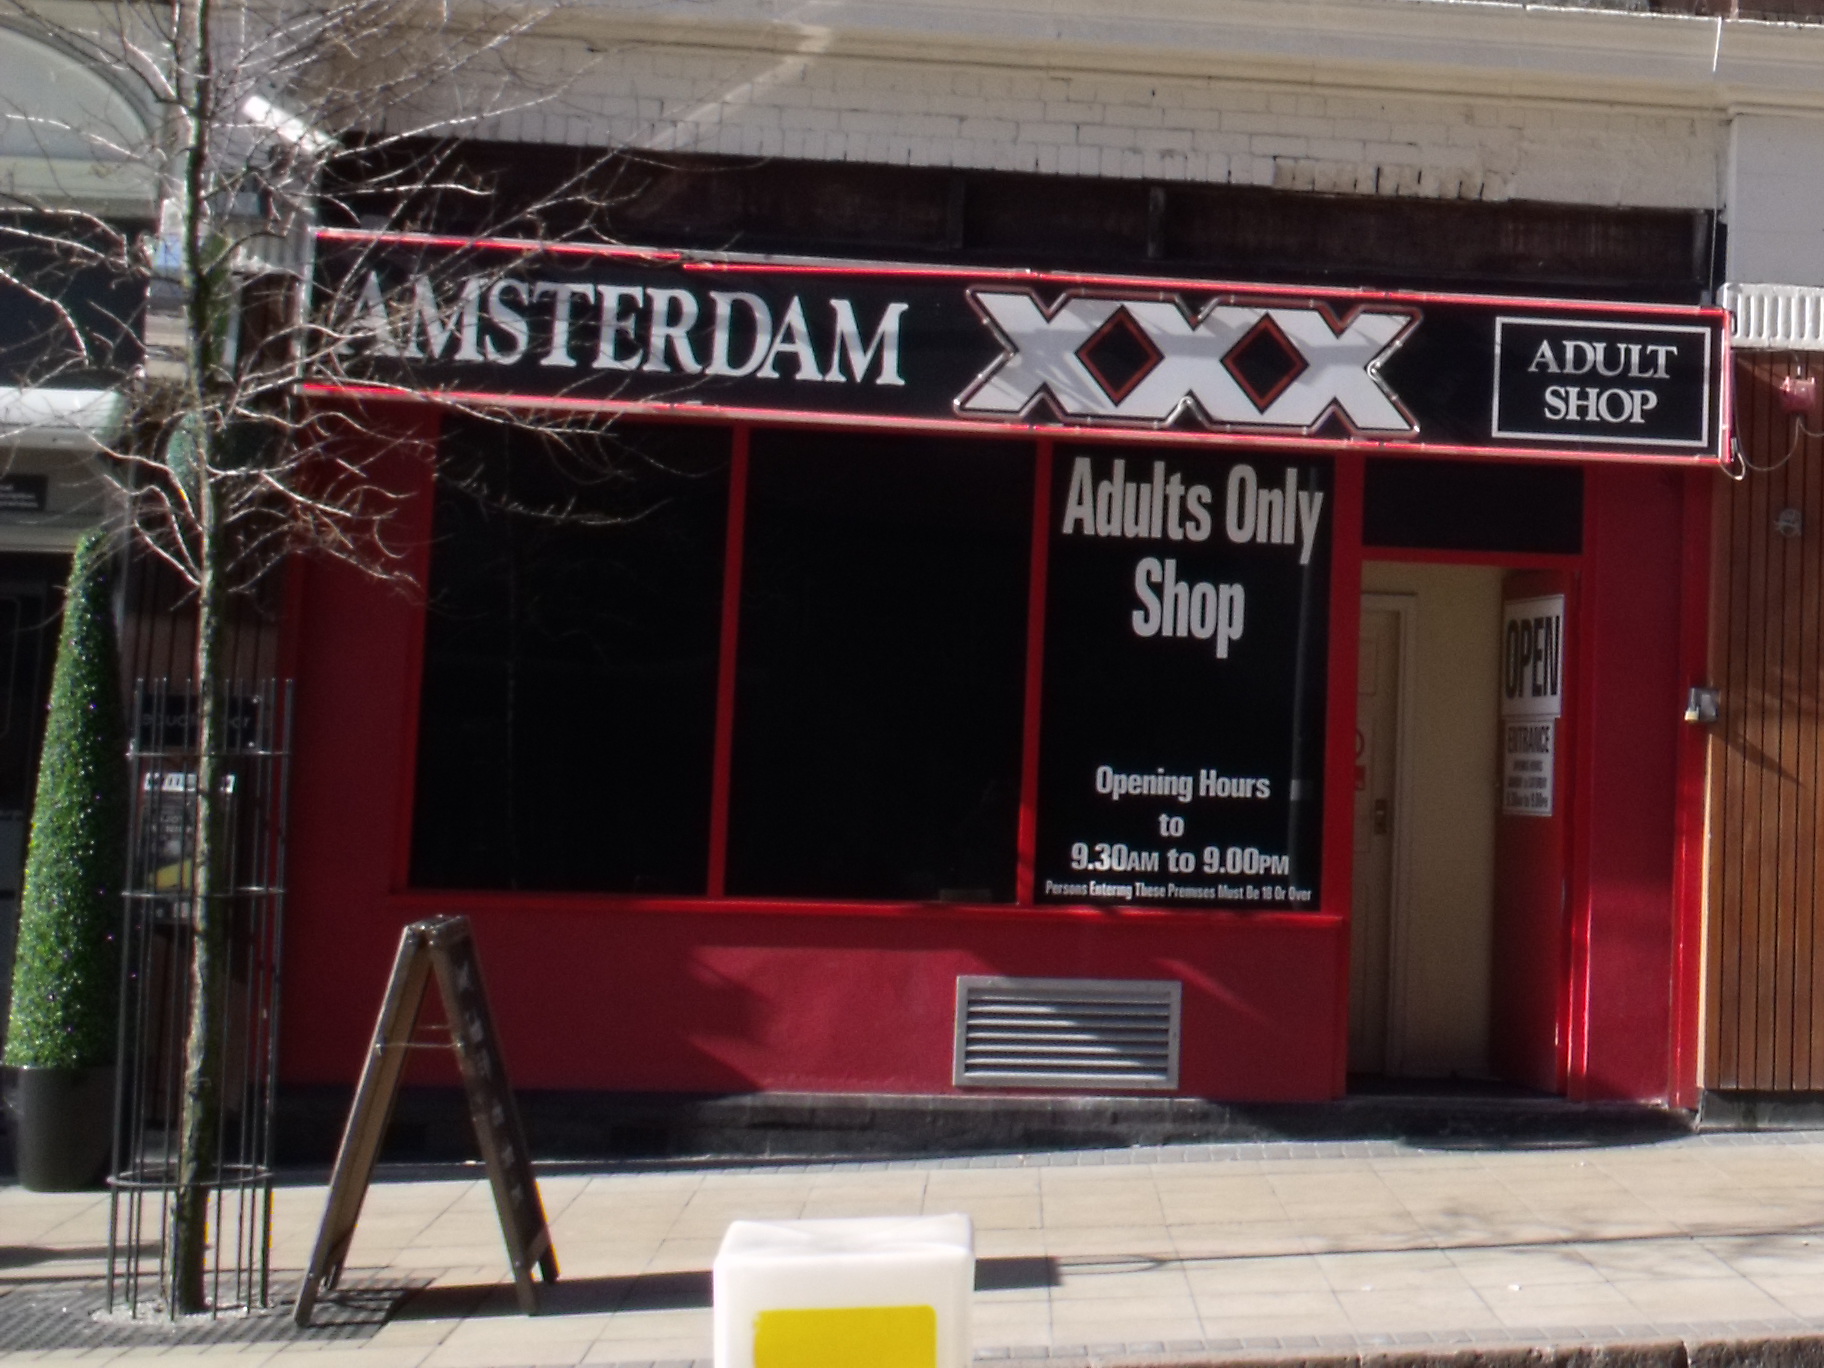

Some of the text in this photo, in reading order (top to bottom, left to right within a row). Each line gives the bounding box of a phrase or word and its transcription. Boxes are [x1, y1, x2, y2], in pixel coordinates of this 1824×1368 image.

[335, 269, 1423, 436] AMSTERDAM XXX
[1527, 339, 1679, 381] ADULT
[1542, 384, 1658, 426] SHOP
[1060, 455, 1324, 565] Adults Only
[1132, 557, 1246, 659] Shop
[1505, 614, 1560, 699] OPEN
[1095, 765, 1271, 803] Opening Hours
[1158, 813, 1185, 837] to
[1071, 842, 1290, 875] 9.30AM to 9.00PM
